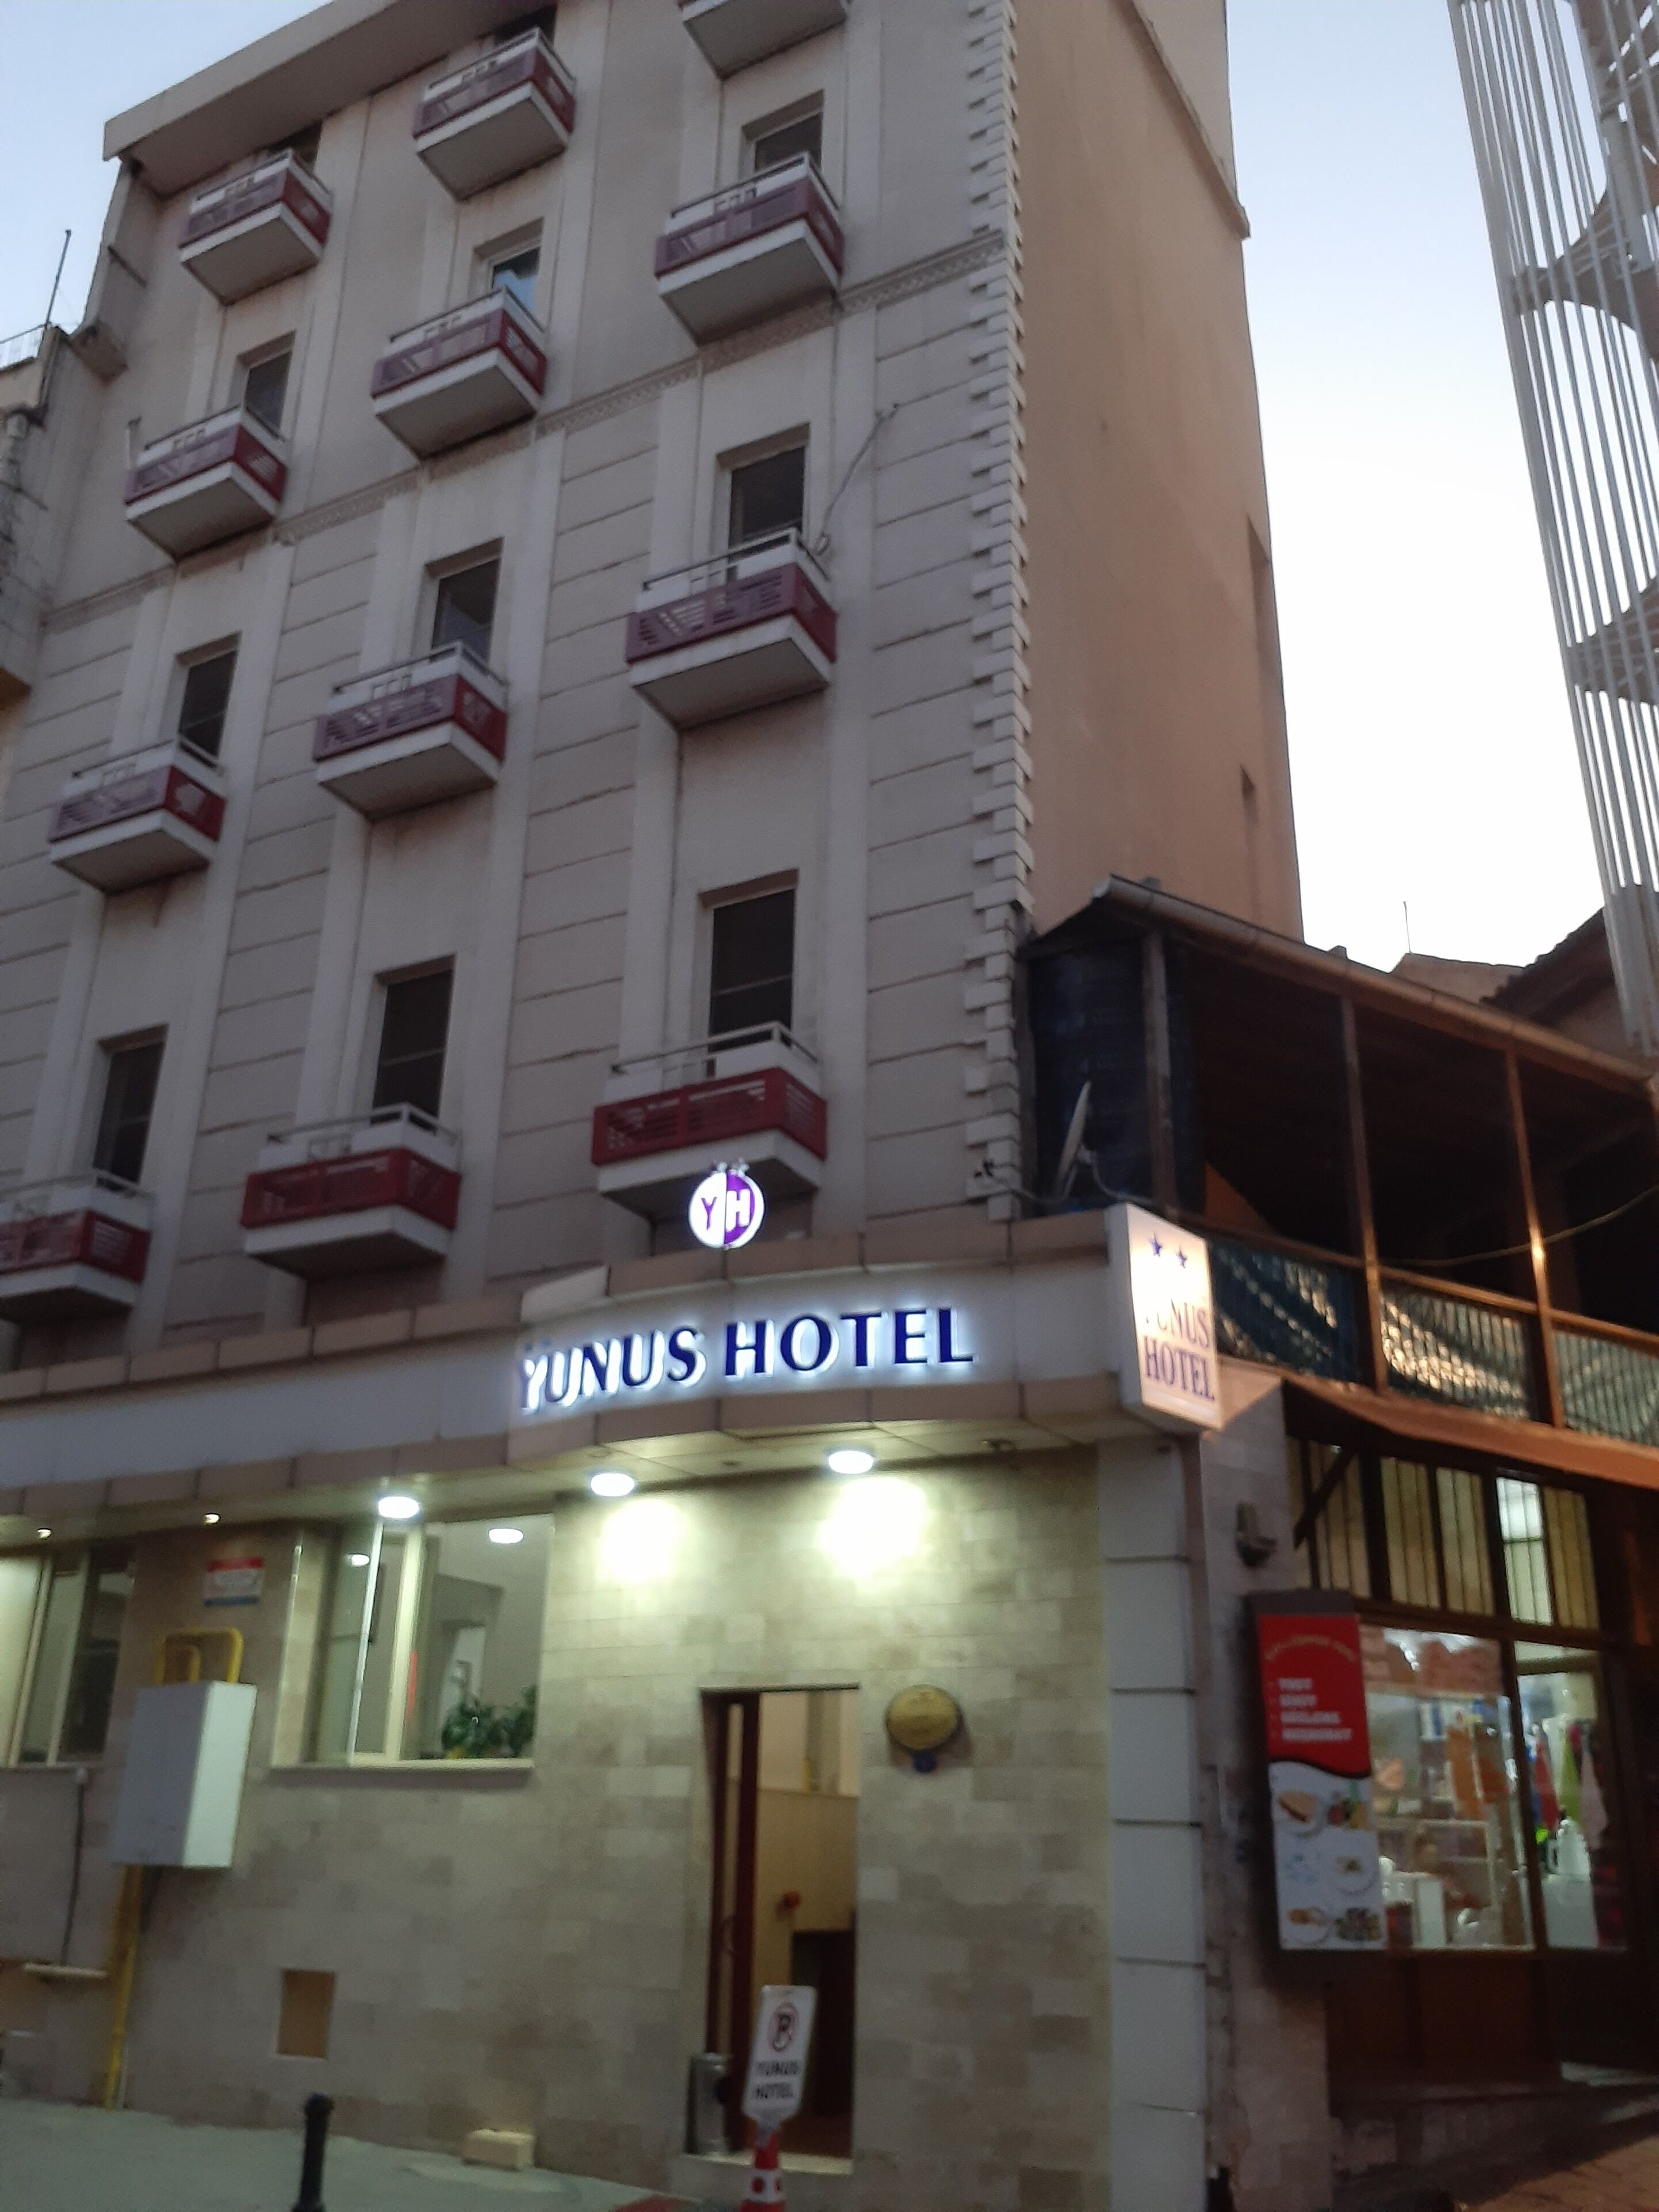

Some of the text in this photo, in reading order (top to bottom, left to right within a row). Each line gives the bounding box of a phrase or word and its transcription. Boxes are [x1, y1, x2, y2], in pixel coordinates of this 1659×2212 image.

[700, 1188, 751, 1231] YH
[520, 1308, 974, 1413] YUNUS HOTEL
[1143, 1335, 1214, 1402] HOTEL
